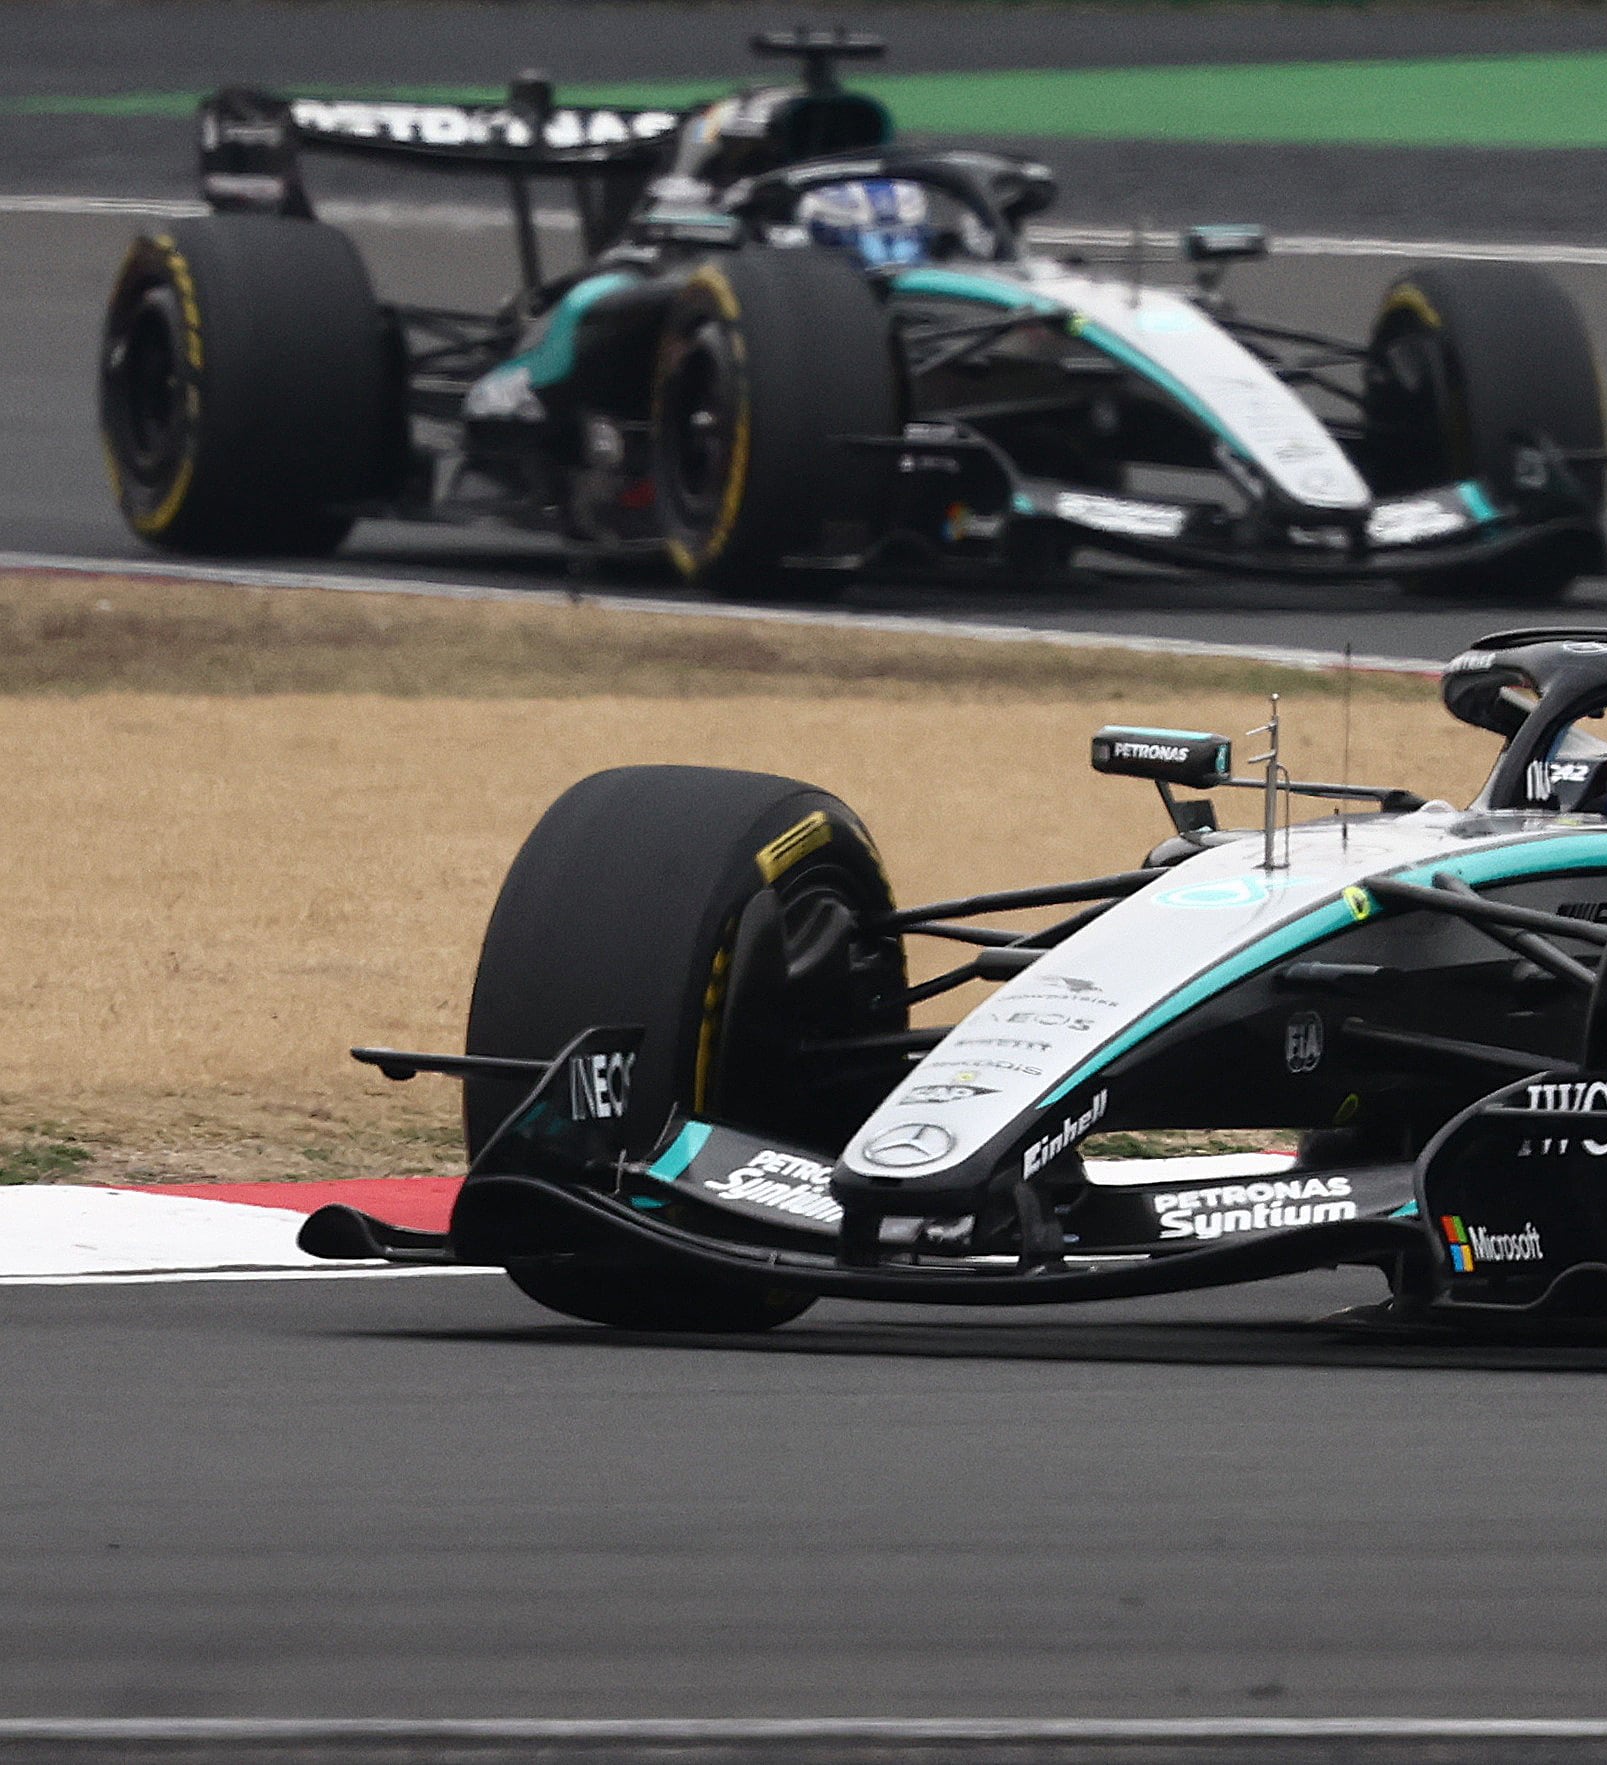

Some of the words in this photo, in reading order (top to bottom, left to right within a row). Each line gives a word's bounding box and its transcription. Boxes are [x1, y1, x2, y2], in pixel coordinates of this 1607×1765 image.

[1114, 742, 1190, 763] PETRONAS
[1022, 1089, 1108, 1181] Einhell
[1154, 1176, 1352, 1214] PETRONAS
[1159, 1200, 1357, 1240] Syntium
[1467, 1222, 1544, 1262] Microsoft
